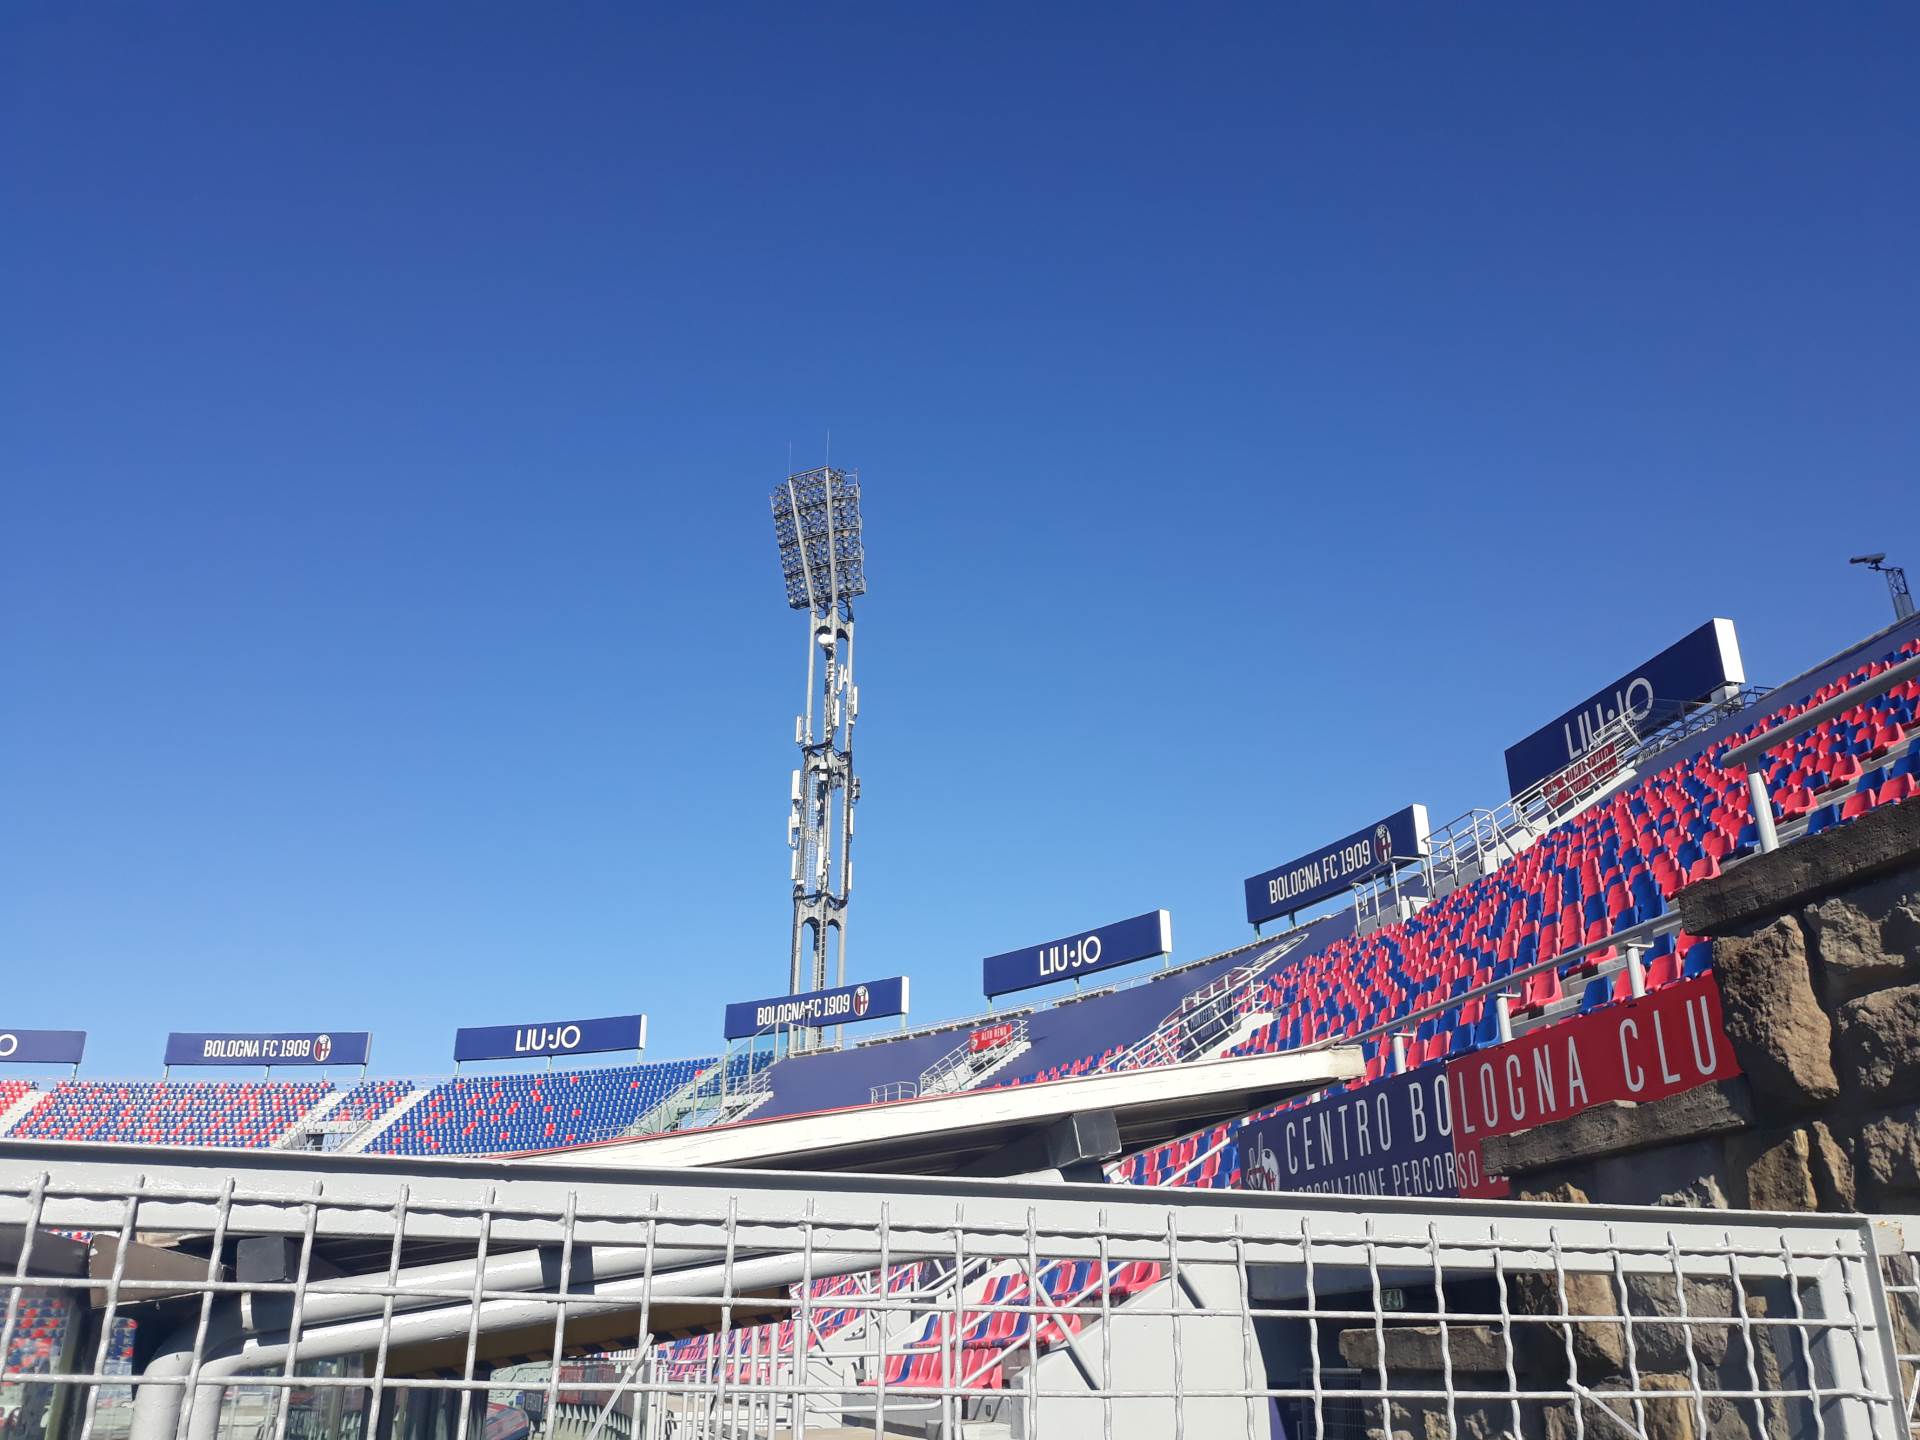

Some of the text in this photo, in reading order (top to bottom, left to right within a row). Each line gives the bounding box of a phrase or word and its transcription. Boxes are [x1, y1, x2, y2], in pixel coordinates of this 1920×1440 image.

[1268, 839, 1371, 905] BOLOGNA FC 1909
[757, 994, 850, 1026] BOLOGNA FC 1909
[203, 1039, 311, 1058] BOLOGNA FC 1909
[1286, 995, 1718, 1173] CENTRO BOLOGNA CLU
[1392, 1149, 1479, 1197] PERCORSO
